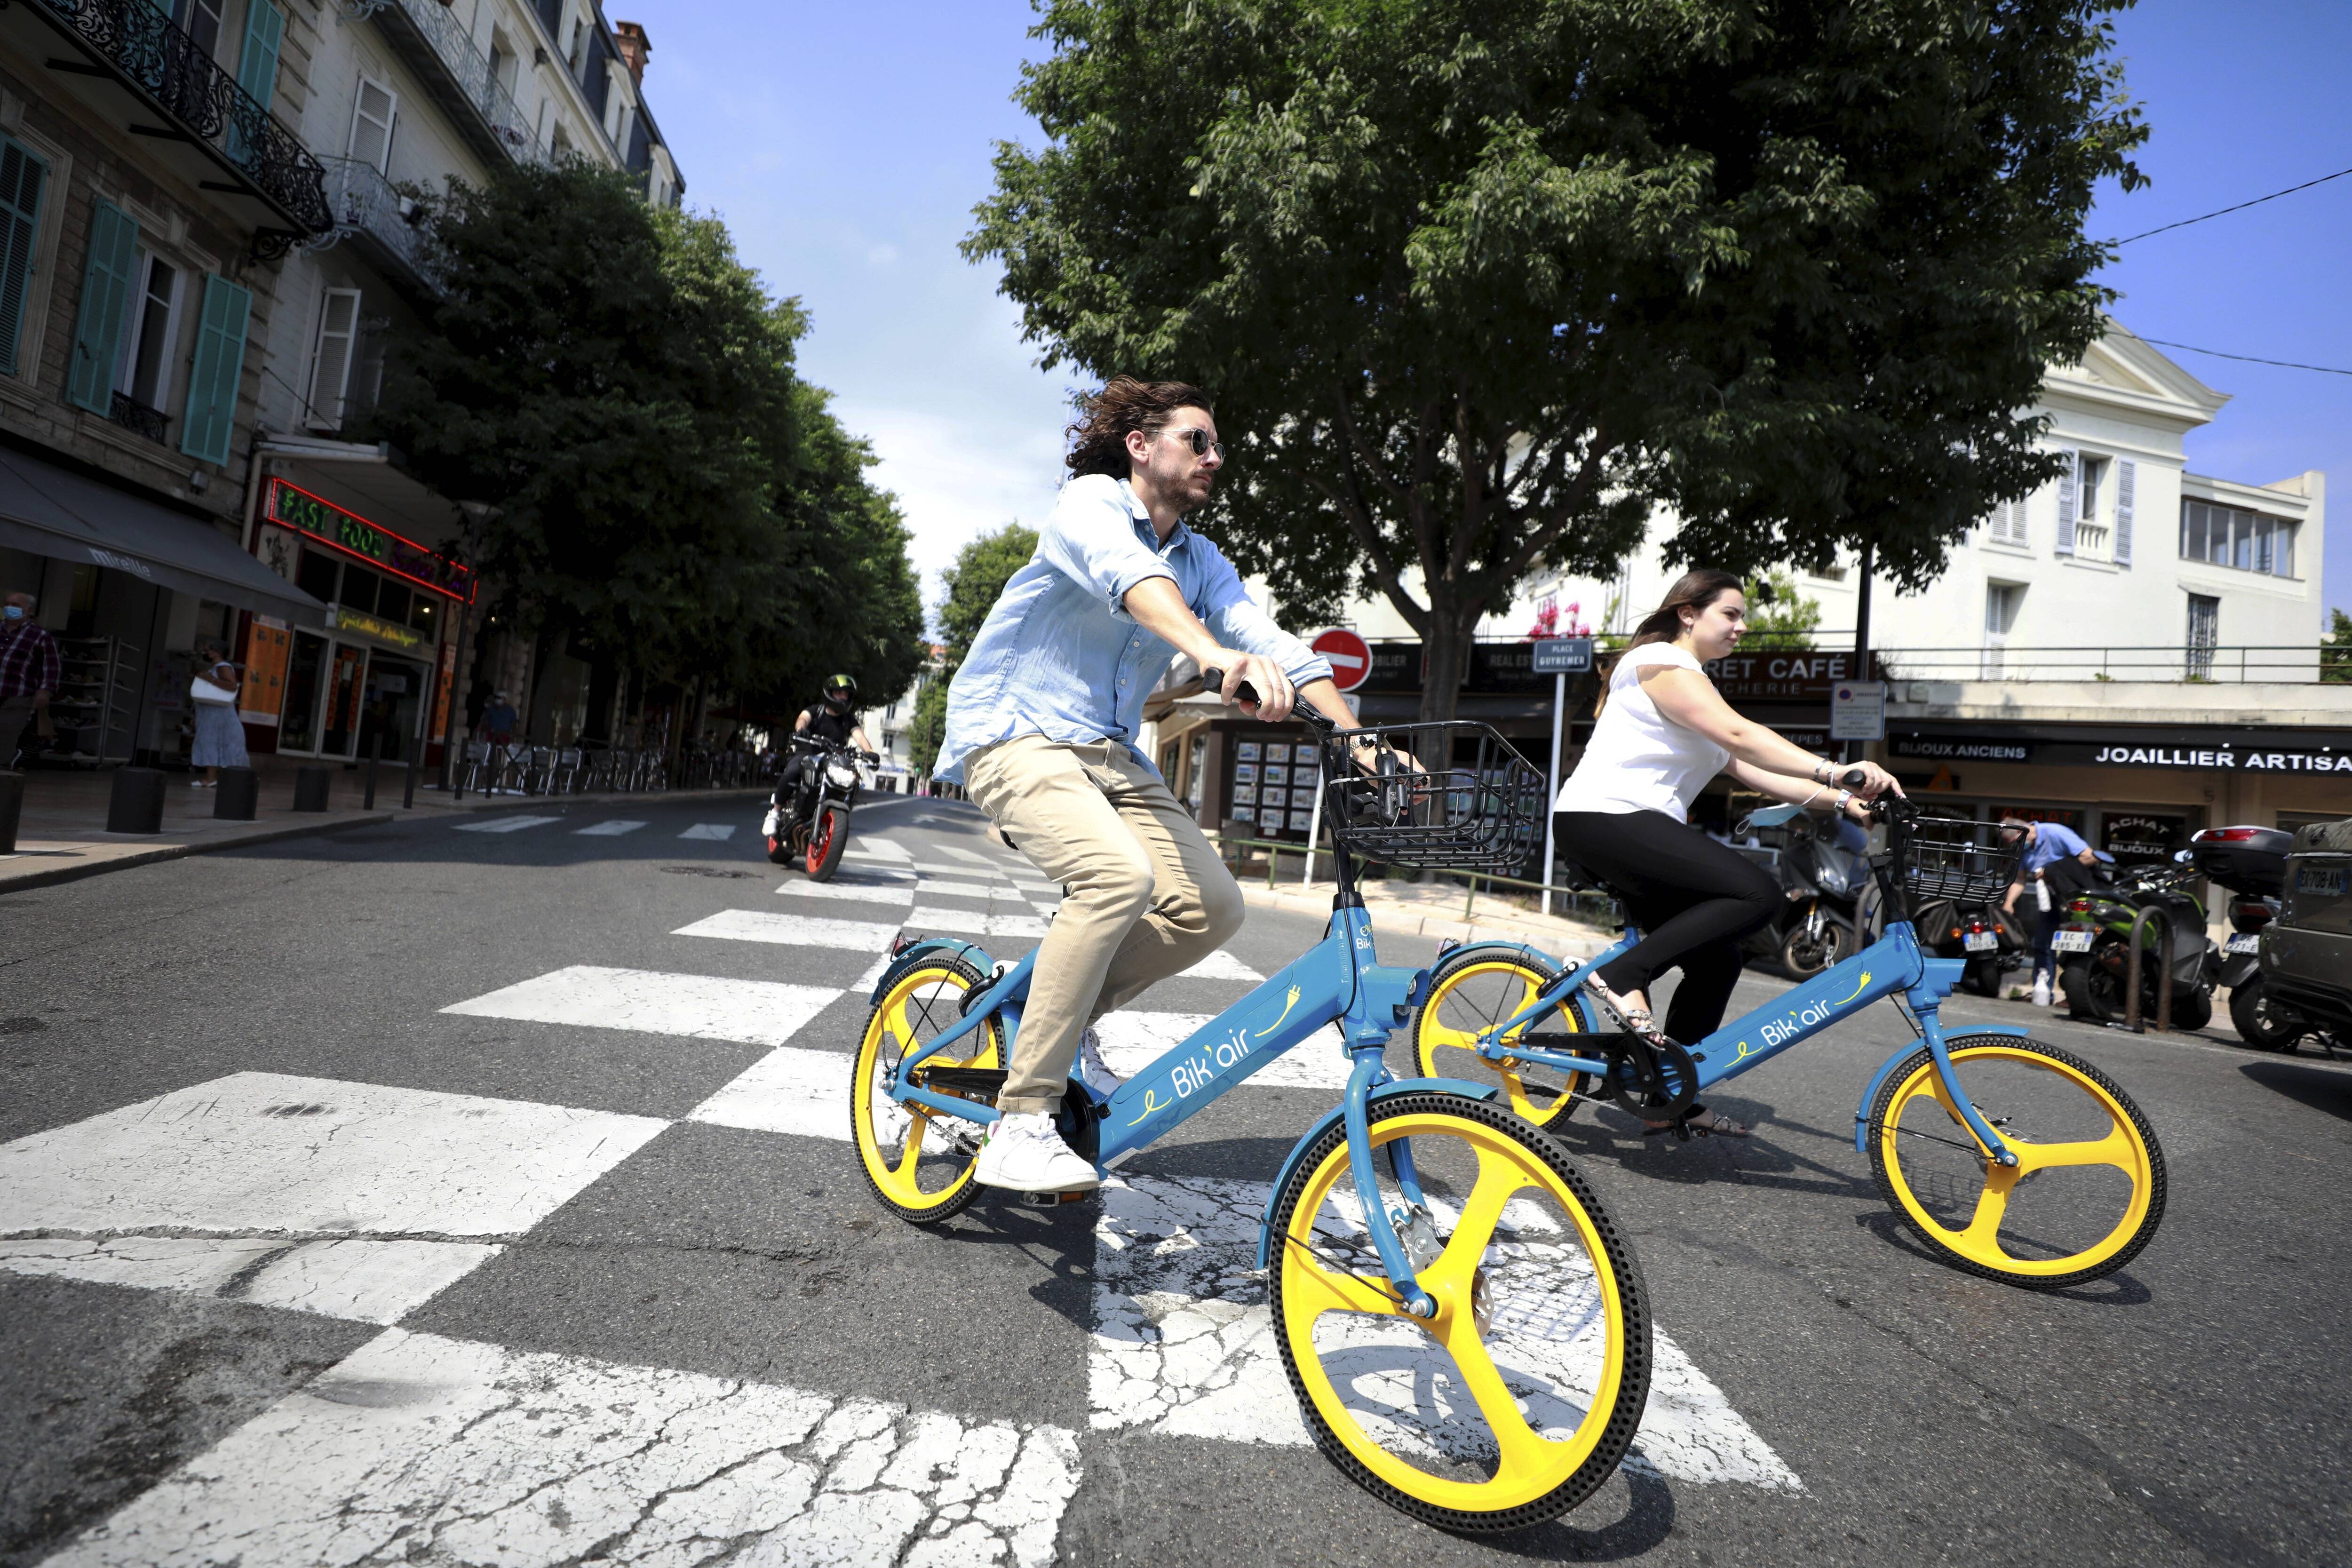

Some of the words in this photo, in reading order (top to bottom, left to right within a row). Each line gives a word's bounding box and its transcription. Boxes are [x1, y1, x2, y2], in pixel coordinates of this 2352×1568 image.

[281, 489, 332, 532] FAST
[339, 517, 384, 557] FOOD
[88, 547, 151, 577] Mireille
[1372, 654, 1406, 667] OBILIER
[1490, 654, 1513, 667] REAL
[1516, 654, 1534, 667] EST
[1539, 655, 1585, 666] GUYNEMER
[1703, 658, 1757, 679] RET
[1769, 654, 1846, 679] CAFÉ
[1899, 742, 1954, 756] BIJOUX
[1955, 745, 2026, 759] ANCIENS
[2096, 747, 2235, 767] JOAILLIER
[2244, 753, 2352, 772] ARTISA
[2205, 790, 2214, 802] 5
[2108, 817, 2170, 834] ACHAT
[2108, 842, 2165, 855] BIJOUX
[2228, 942, 2257, 951] 271-E
